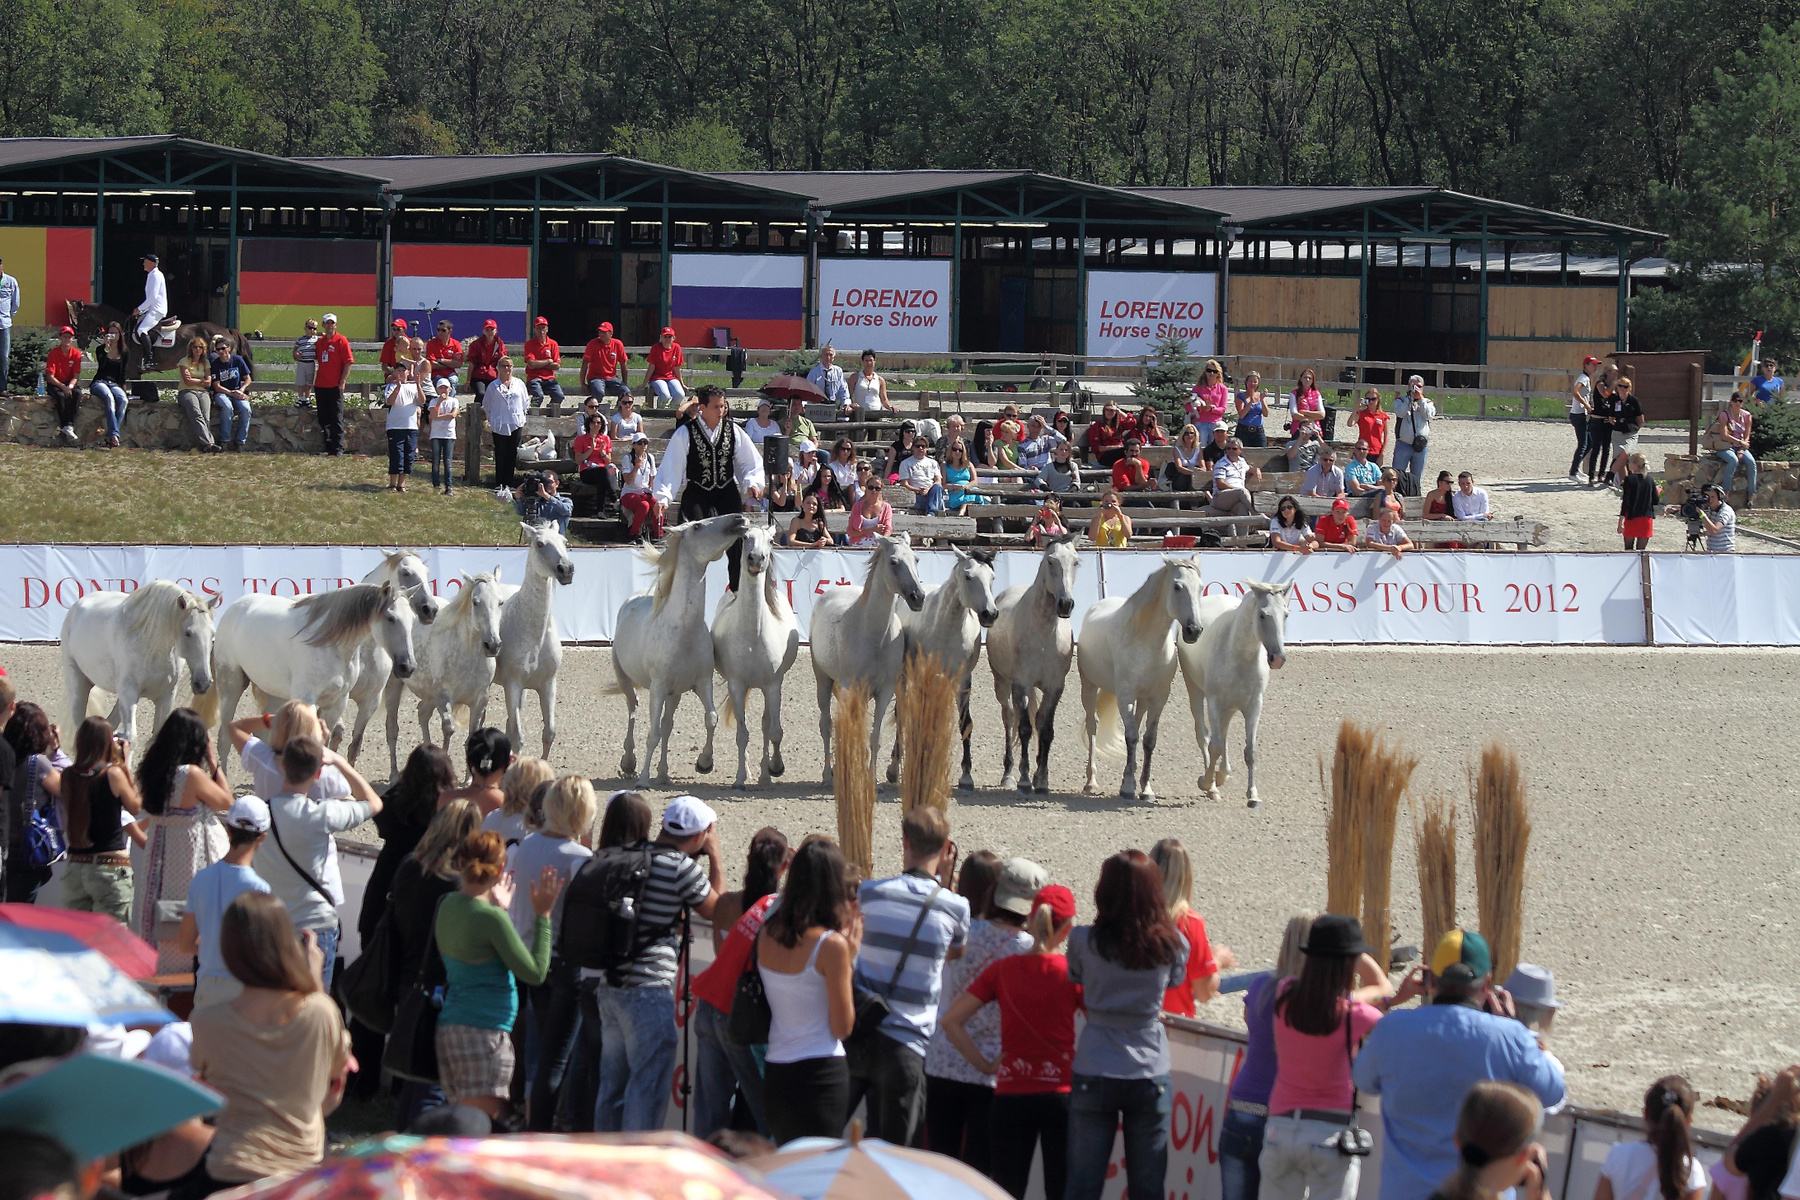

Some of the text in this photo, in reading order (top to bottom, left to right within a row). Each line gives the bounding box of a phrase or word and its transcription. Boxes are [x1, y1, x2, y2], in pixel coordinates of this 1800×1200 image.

[831, 288, 938, 308] LORENZO
[830, 310, 938, 327] Horse Show
[1100, 300, 1204, 320] LORENZO
[1099, 322, 1203, 338] Horse Show
[242, 577, 354, 596] TOU
[1374, 582, 1486, 613] TOUR
[1503, 583, 1580, 613] 2012
